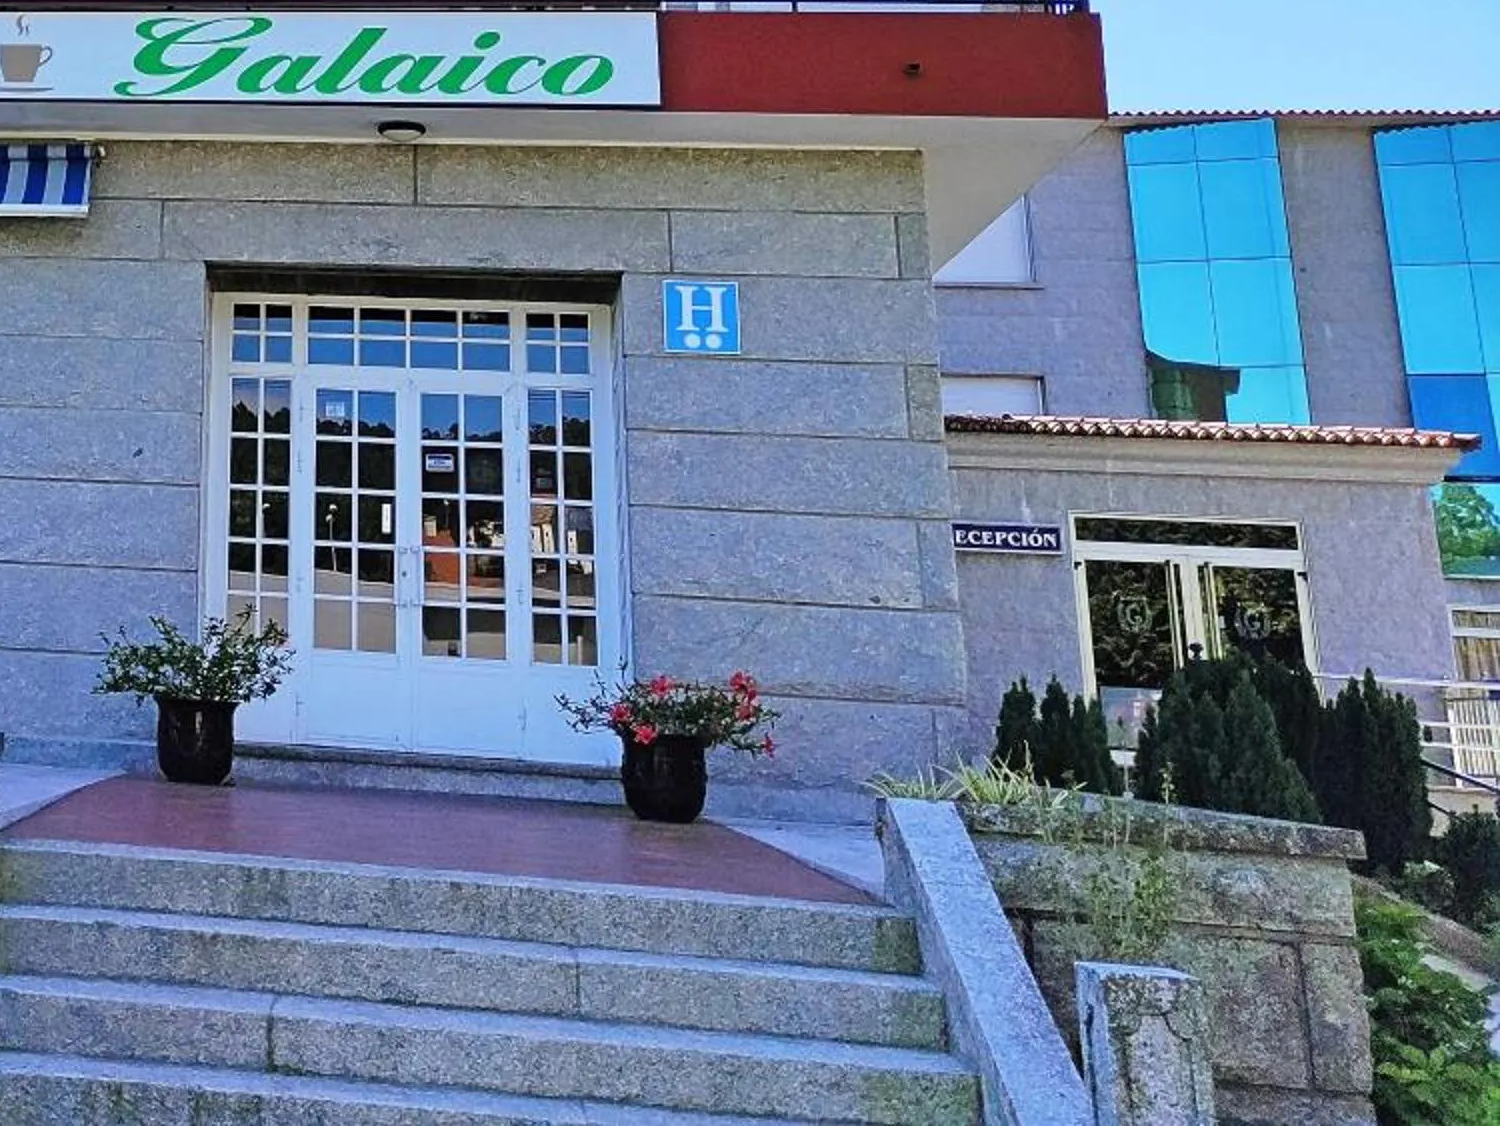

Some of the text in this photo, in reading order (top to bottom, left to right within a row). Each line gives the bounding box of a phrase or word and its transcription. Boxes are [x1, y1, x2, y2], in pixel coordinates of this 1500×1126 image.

[113, 17, 614, 97] Galaico
[675, 285, 729, 333] H
[955, 527, 1058, 547] ECEPCIÓN
